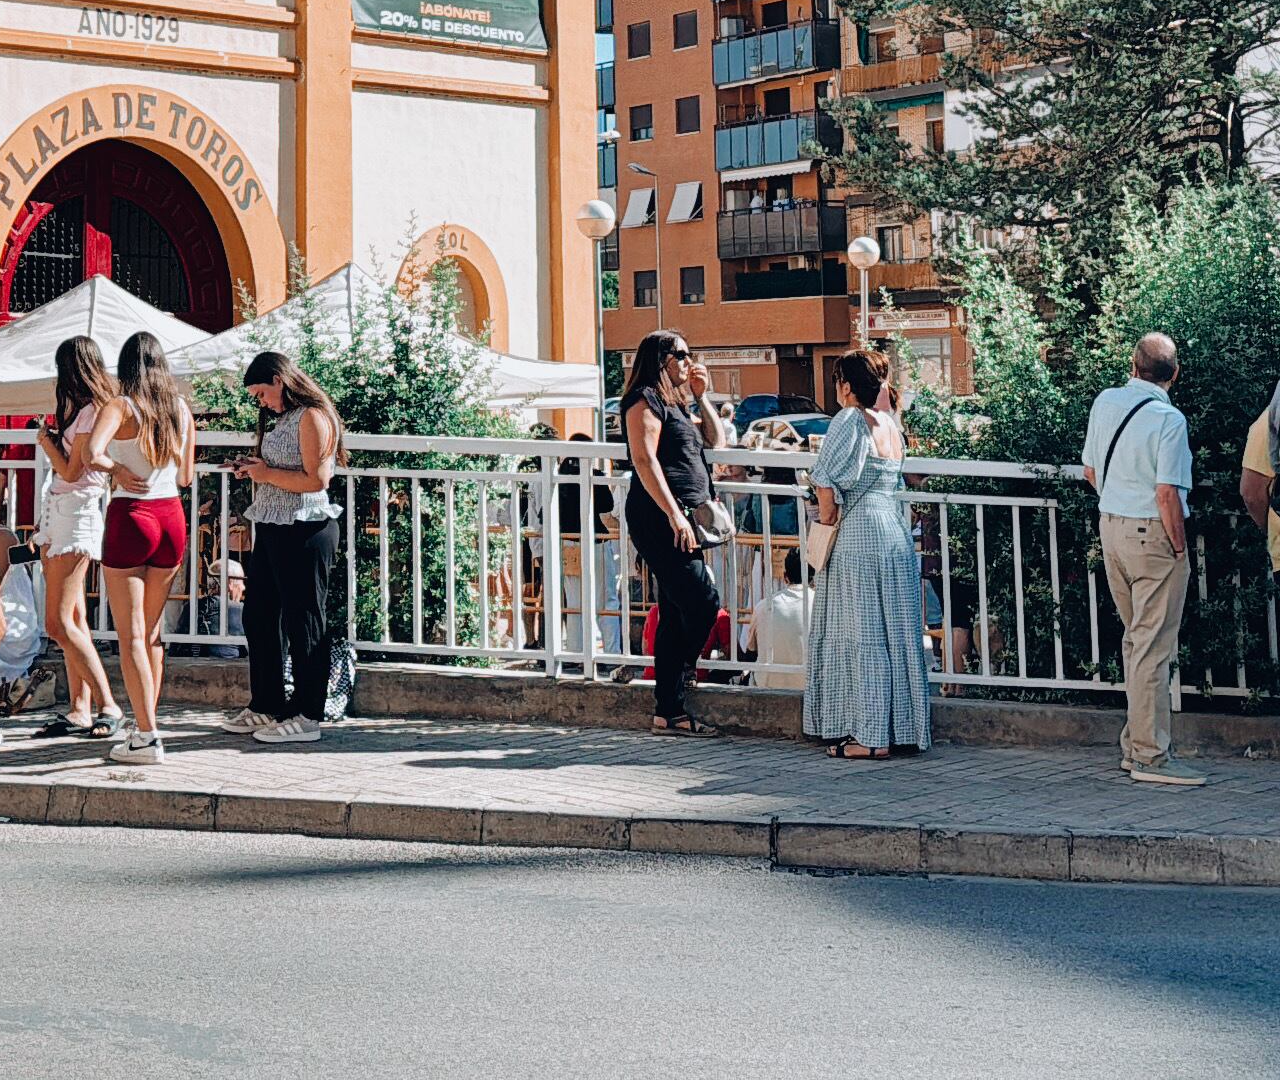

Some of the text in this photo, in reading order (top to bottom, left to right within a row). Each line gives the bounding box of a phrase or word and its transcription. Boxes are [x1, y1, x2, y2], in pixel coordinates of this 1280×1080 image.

[380, 10, 525, 43] 20% DE DESCUENTO
[420, 1, 492, 24] ¡ABÓNATE!
[111, 92, 158, 132] DE
[167, 101, 263, 212] TOROS
